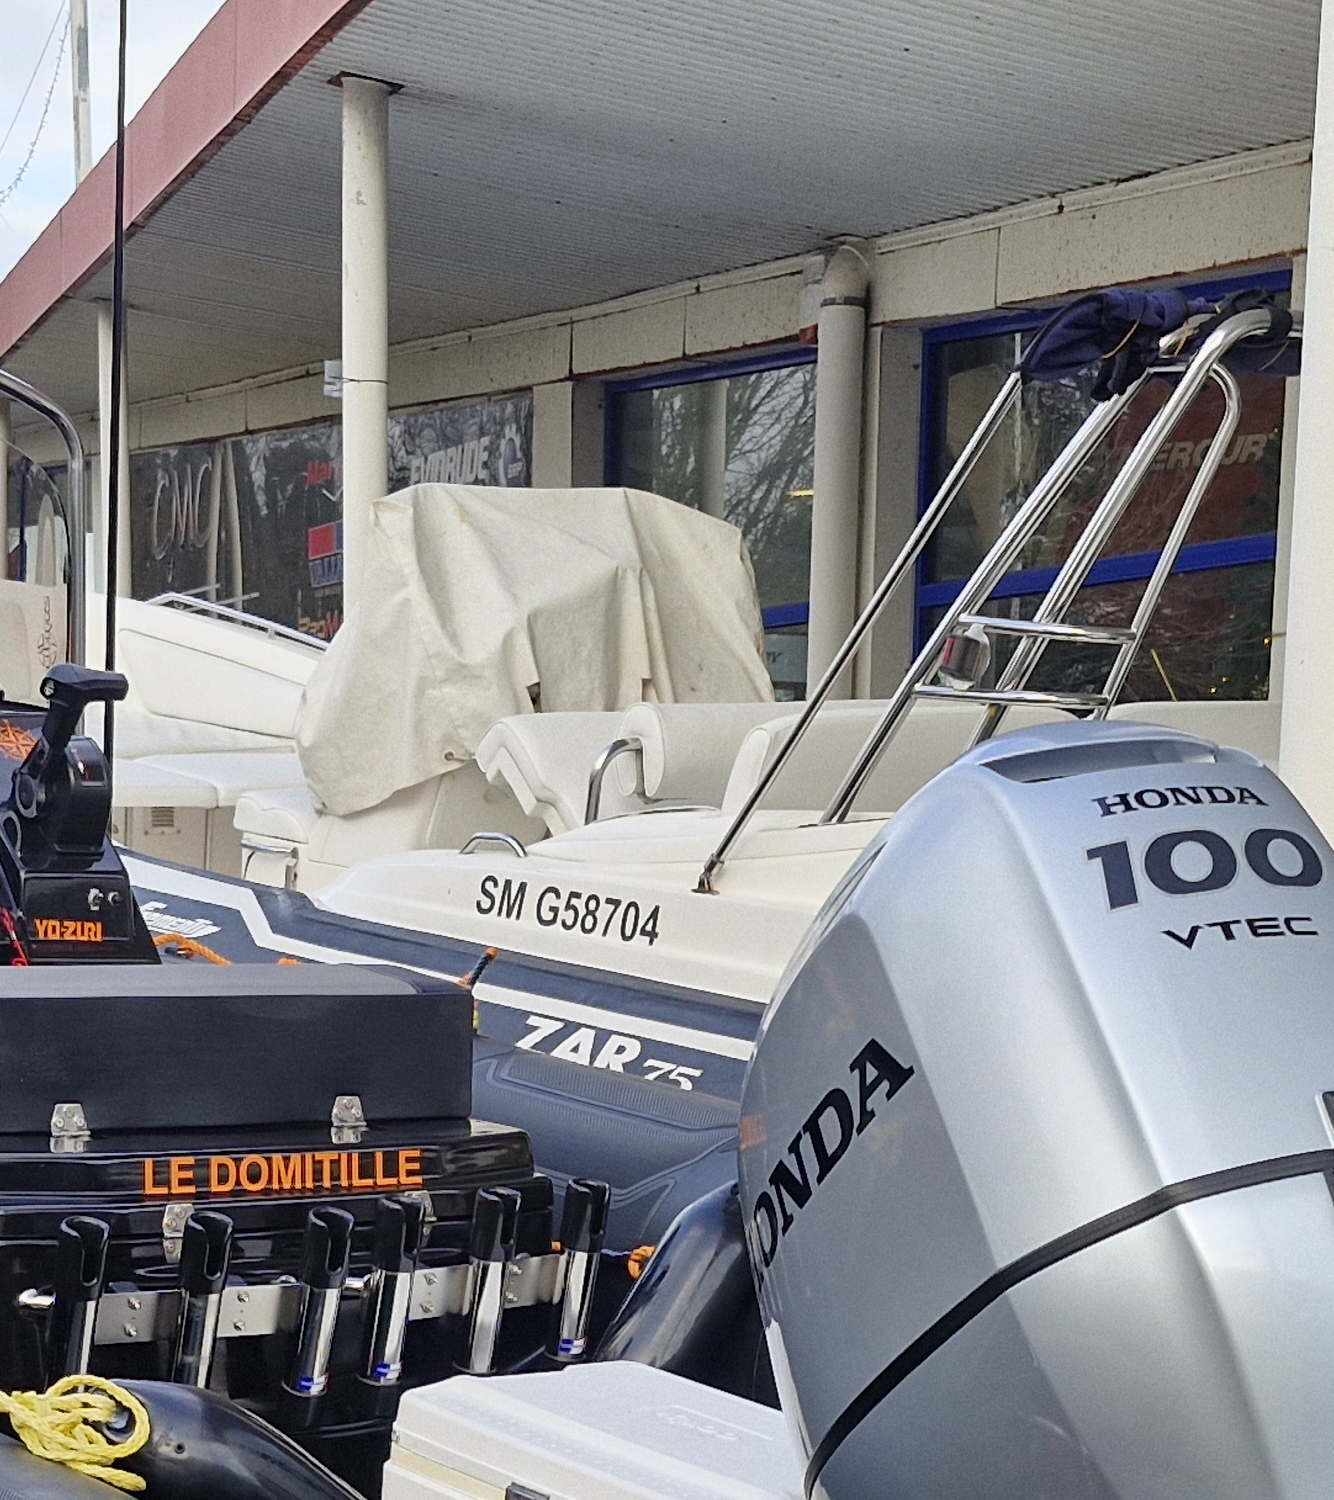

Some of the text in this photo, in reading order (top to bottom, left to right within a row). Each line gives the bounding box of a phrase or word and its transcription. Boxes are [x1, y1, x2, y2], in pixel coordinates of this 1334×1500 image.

[1090, 784, 1269, 818] HONDA
[1086, 827, 1324, 911] 100
[475, 874, 662, 947] SM G58704
[1161, 916, 1319, 950] VTEC
[514, 1014, 705, 1092] ZAR 75
[143, 1149, 424, 1195] LE DOMITILLE
